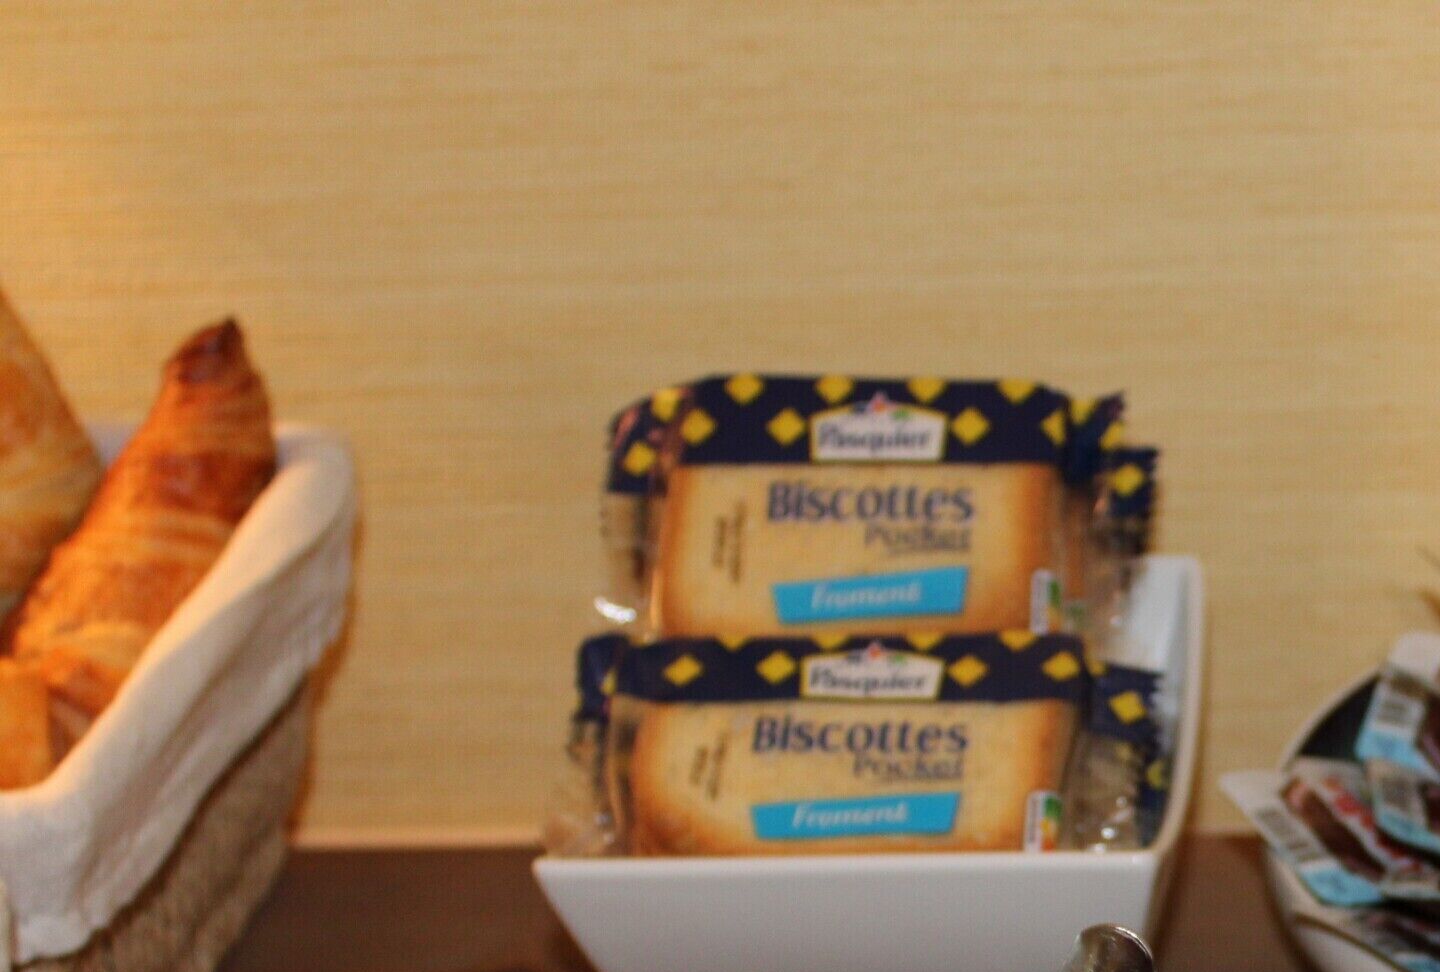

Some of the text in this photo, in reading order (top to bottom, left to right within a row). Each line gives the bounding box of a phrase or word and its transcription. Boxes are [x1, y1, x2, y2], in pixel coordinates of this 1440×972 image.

[767, 480, 976, 523] Biscottes
[753, 713, 969, 753] Biscottes
[791, 802, 909, 829] Froment
